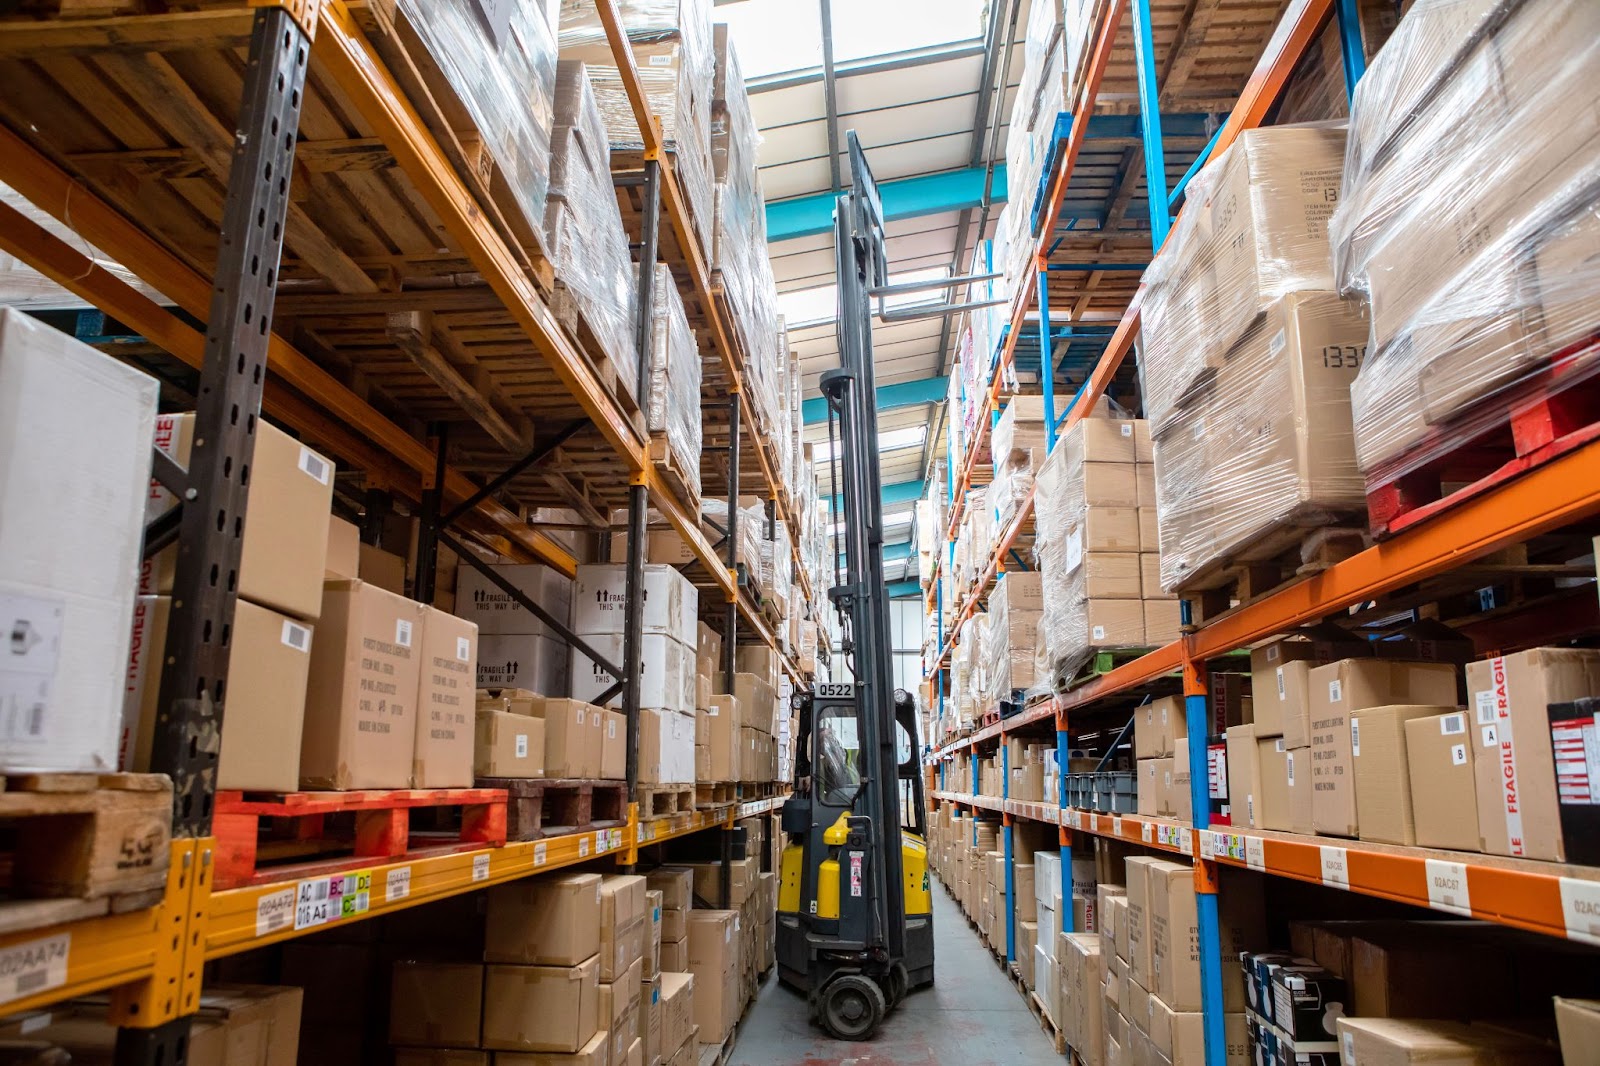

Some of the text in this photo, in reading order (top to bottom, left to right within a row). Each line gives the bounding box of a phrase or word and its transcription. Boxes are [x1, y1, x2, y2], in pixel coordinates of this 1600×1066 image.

[599, 603, 613, 611] THIS
[480, 666, 506, 674] FRAGILE
[489, 675, 502, 683] WAY
[507, 675, 515, 683] UP
[595, 675, 610, 683] THIS
[1489, 730, 1495, 741] A
[1457, 749, 1463, 760] B
[1501, 741, 1518, 813] FRAGILE
